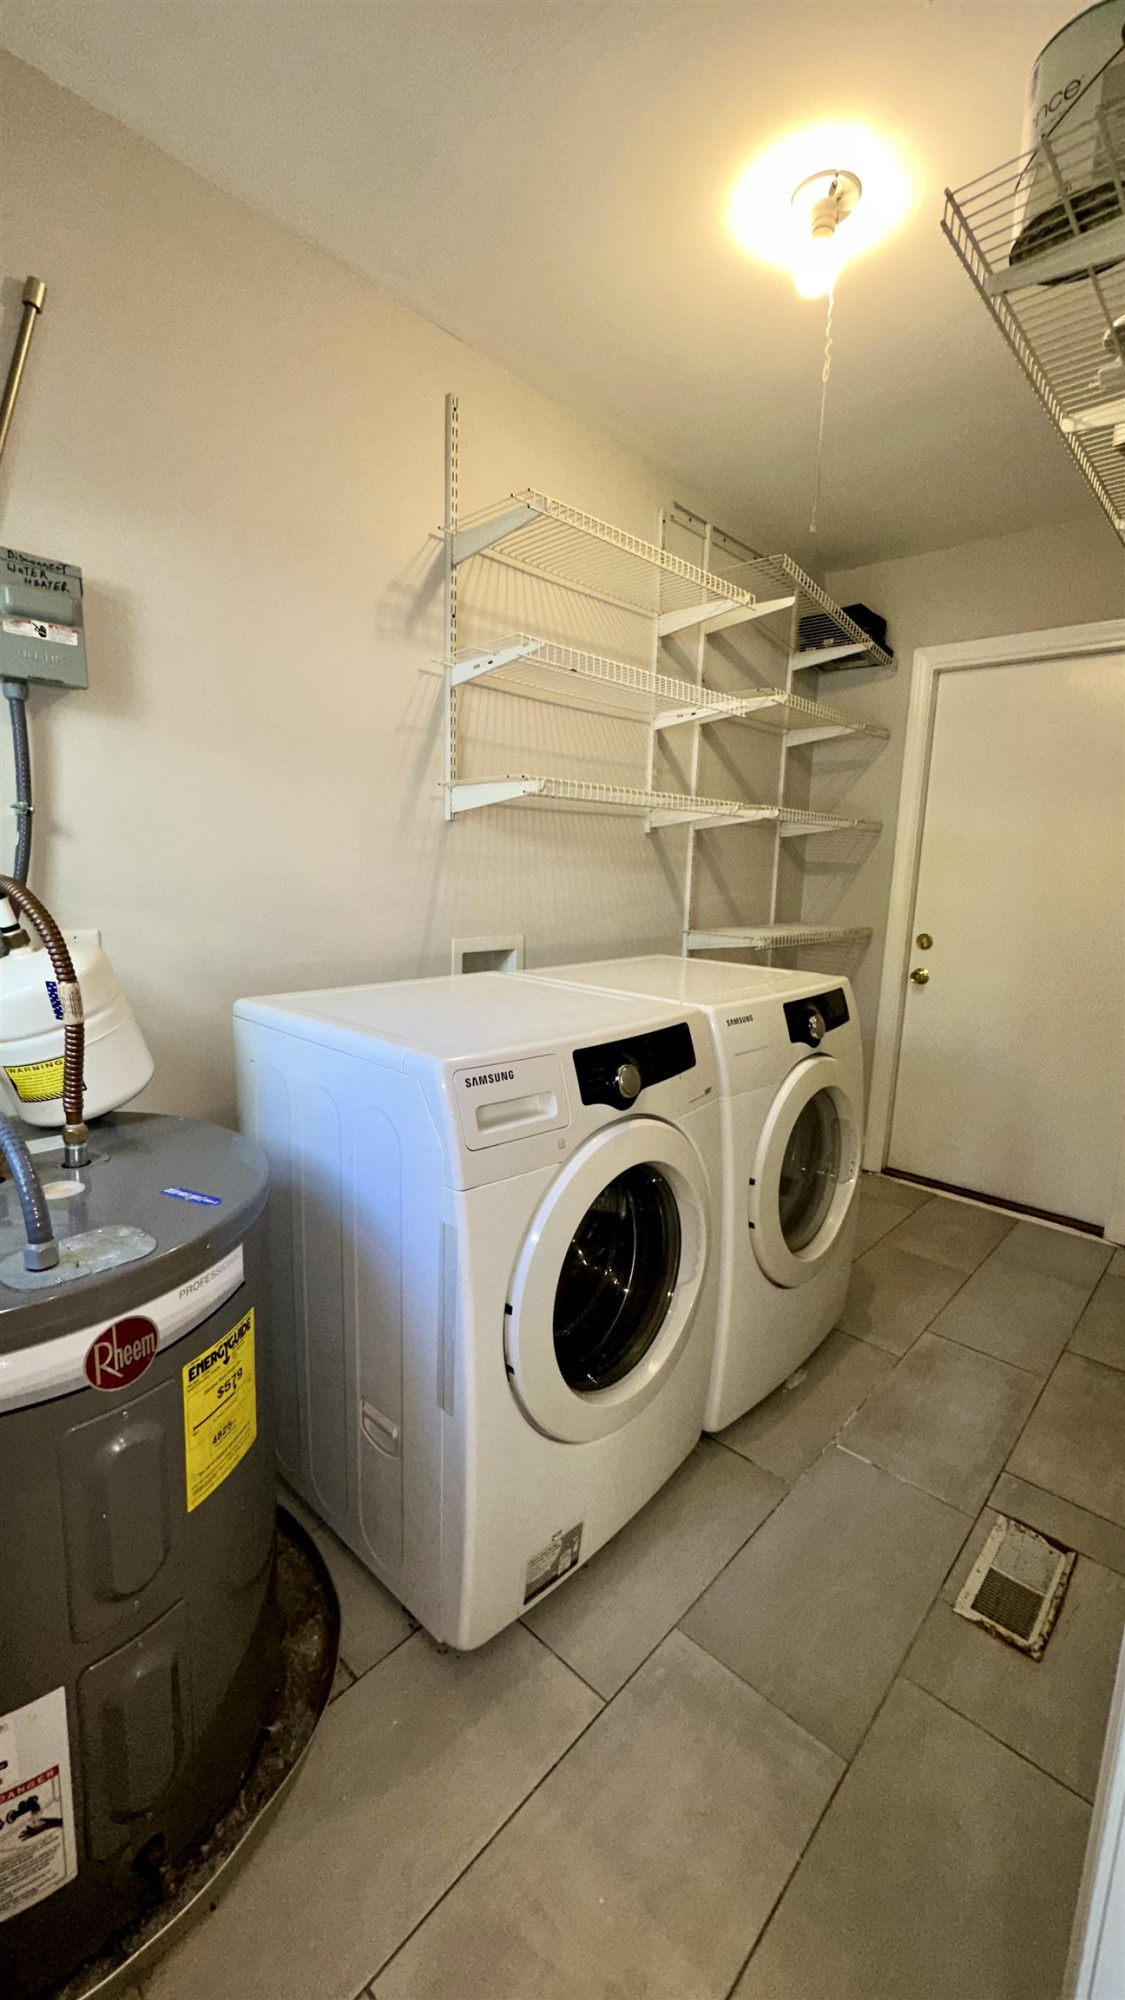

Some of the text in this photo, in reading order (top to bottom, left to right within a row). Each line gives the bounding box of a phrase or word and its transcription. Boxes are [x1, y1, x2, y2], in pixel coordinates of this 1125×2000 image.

[726, 1014, 754, 1027] SAMSUNG
[7, 1060, 63, 1074] WARNING
[464, 1070, 515, 1088] SAMSUNG
[93, 1323, 156, 1387] Rheem
